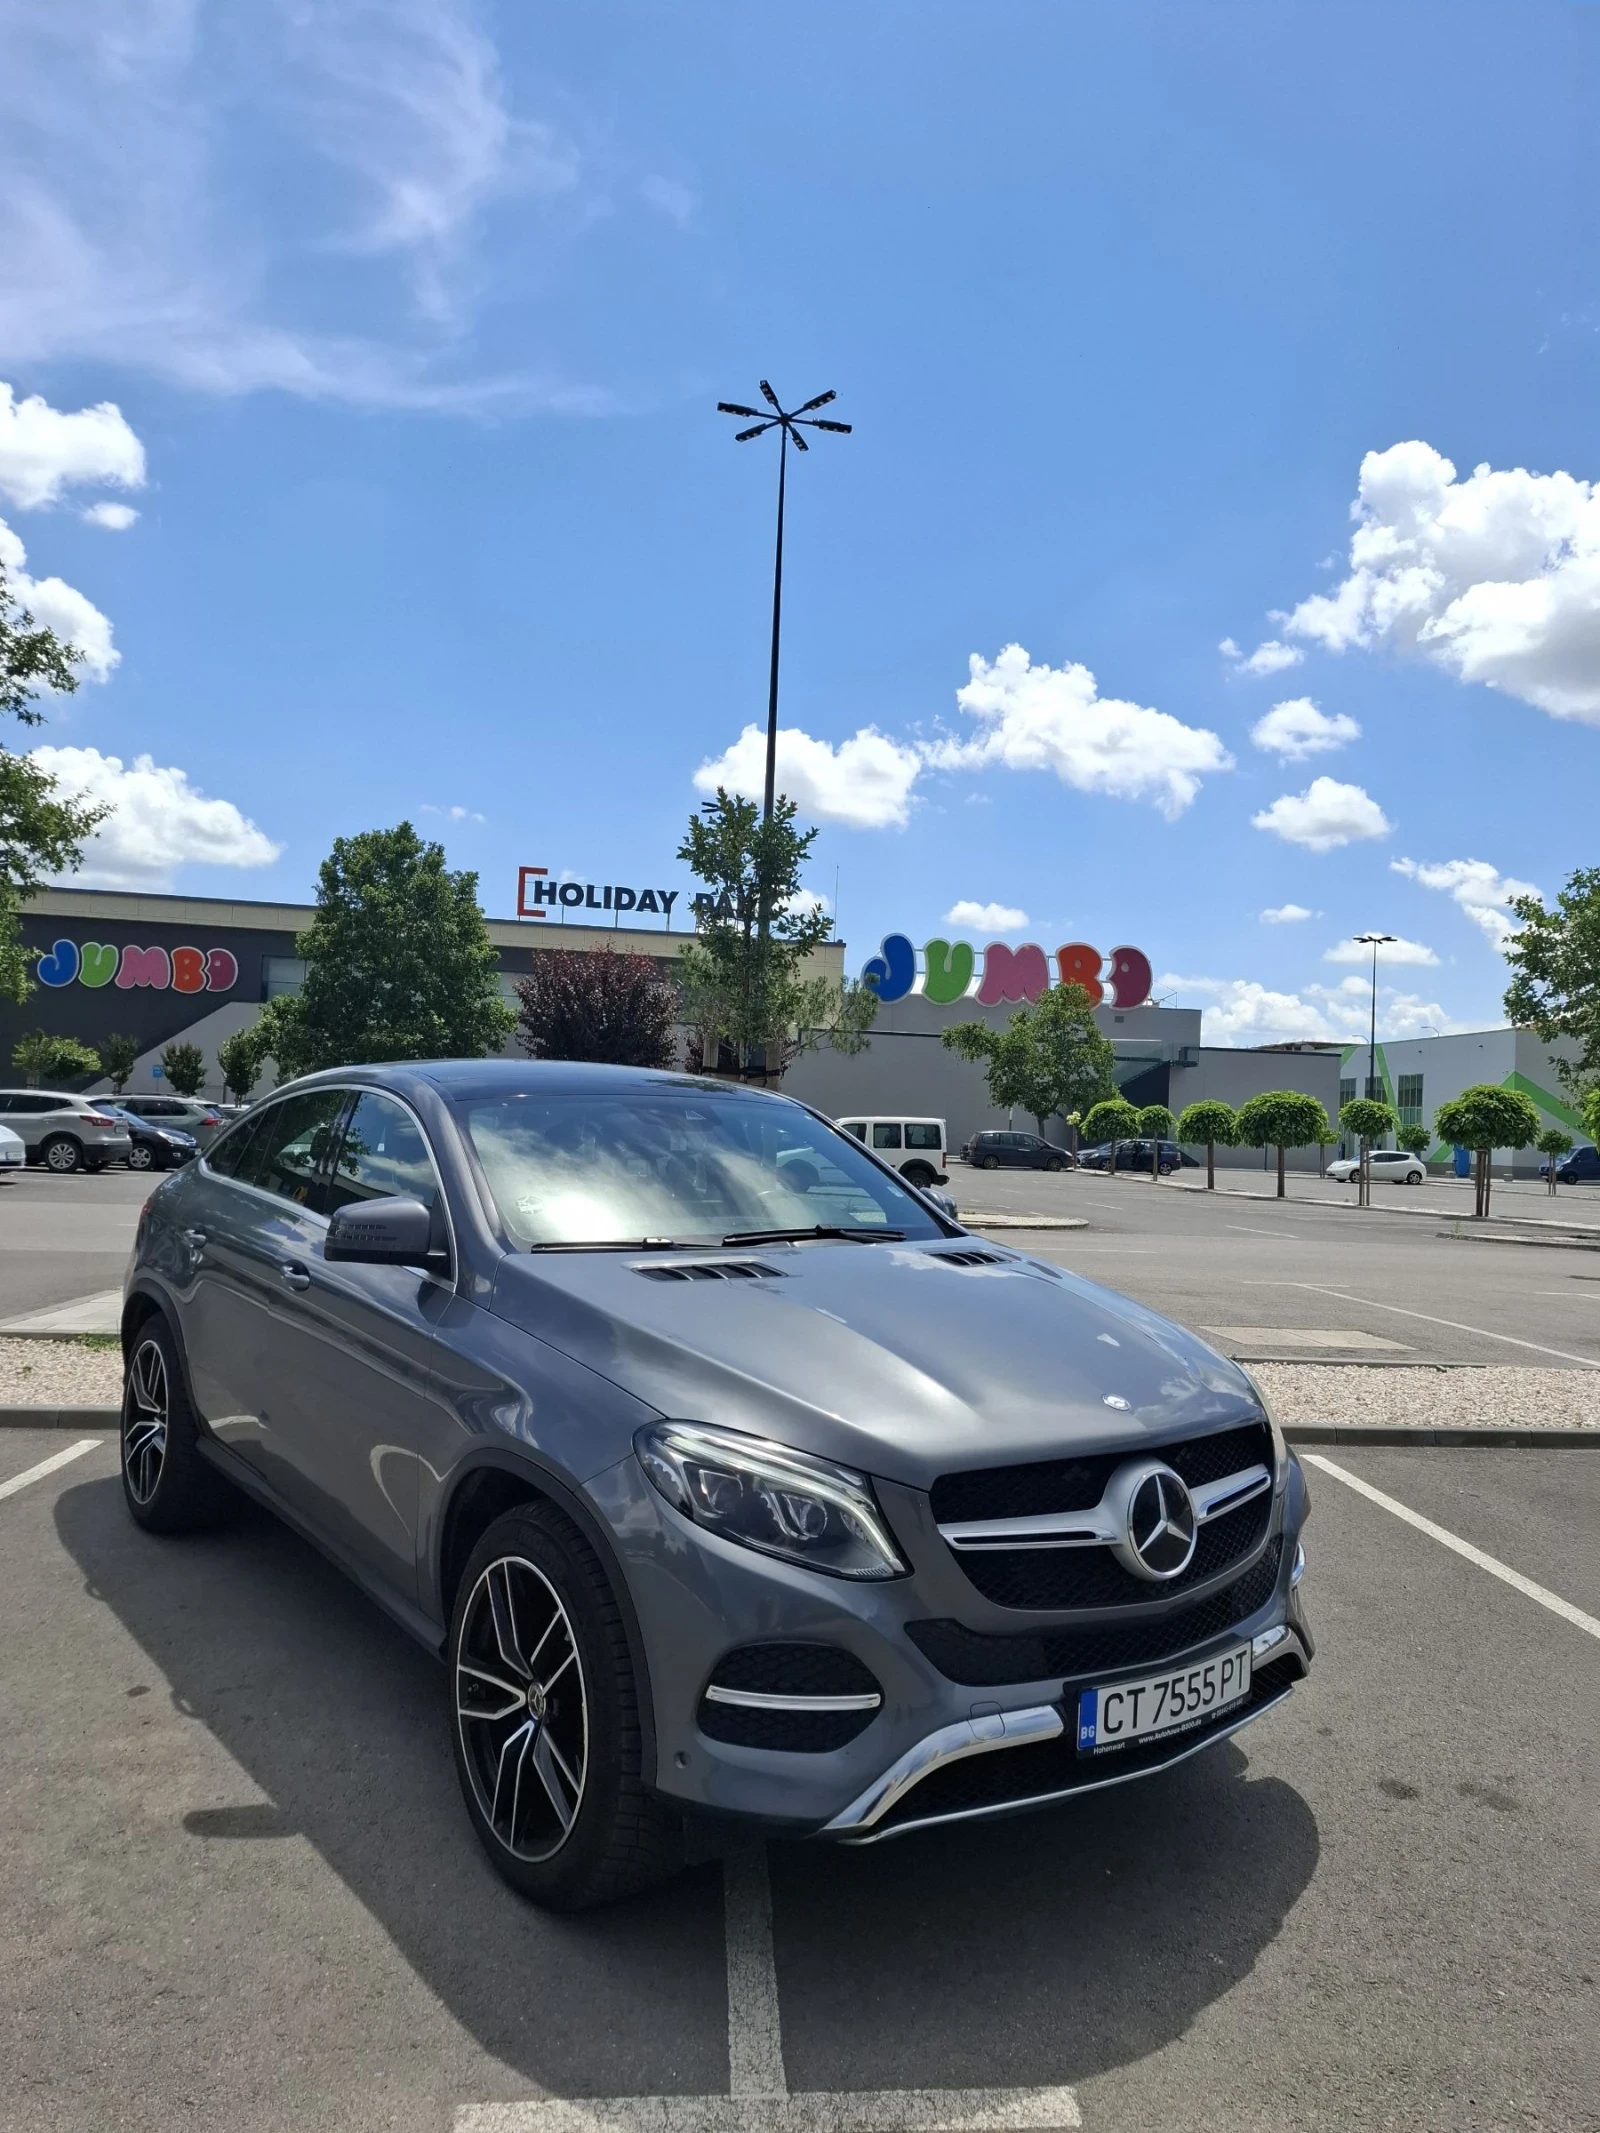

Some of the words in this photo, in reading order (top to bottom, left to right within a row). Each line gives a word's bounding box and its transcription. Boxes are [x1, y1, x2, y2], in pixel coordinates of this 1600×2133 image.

[534, 880, 679, 914] HOLIDAY
[37, 938, 239, 994] JUMBO
[861, 932, 1154, 1011] JUMBO
[1103, 1686, 1146, 1735] CT
[1152, 1664, 1216, 1724] 7555
[1220, 1650, 1248, 1699] PT
[1080, 1725, 1095, 1740] BG
